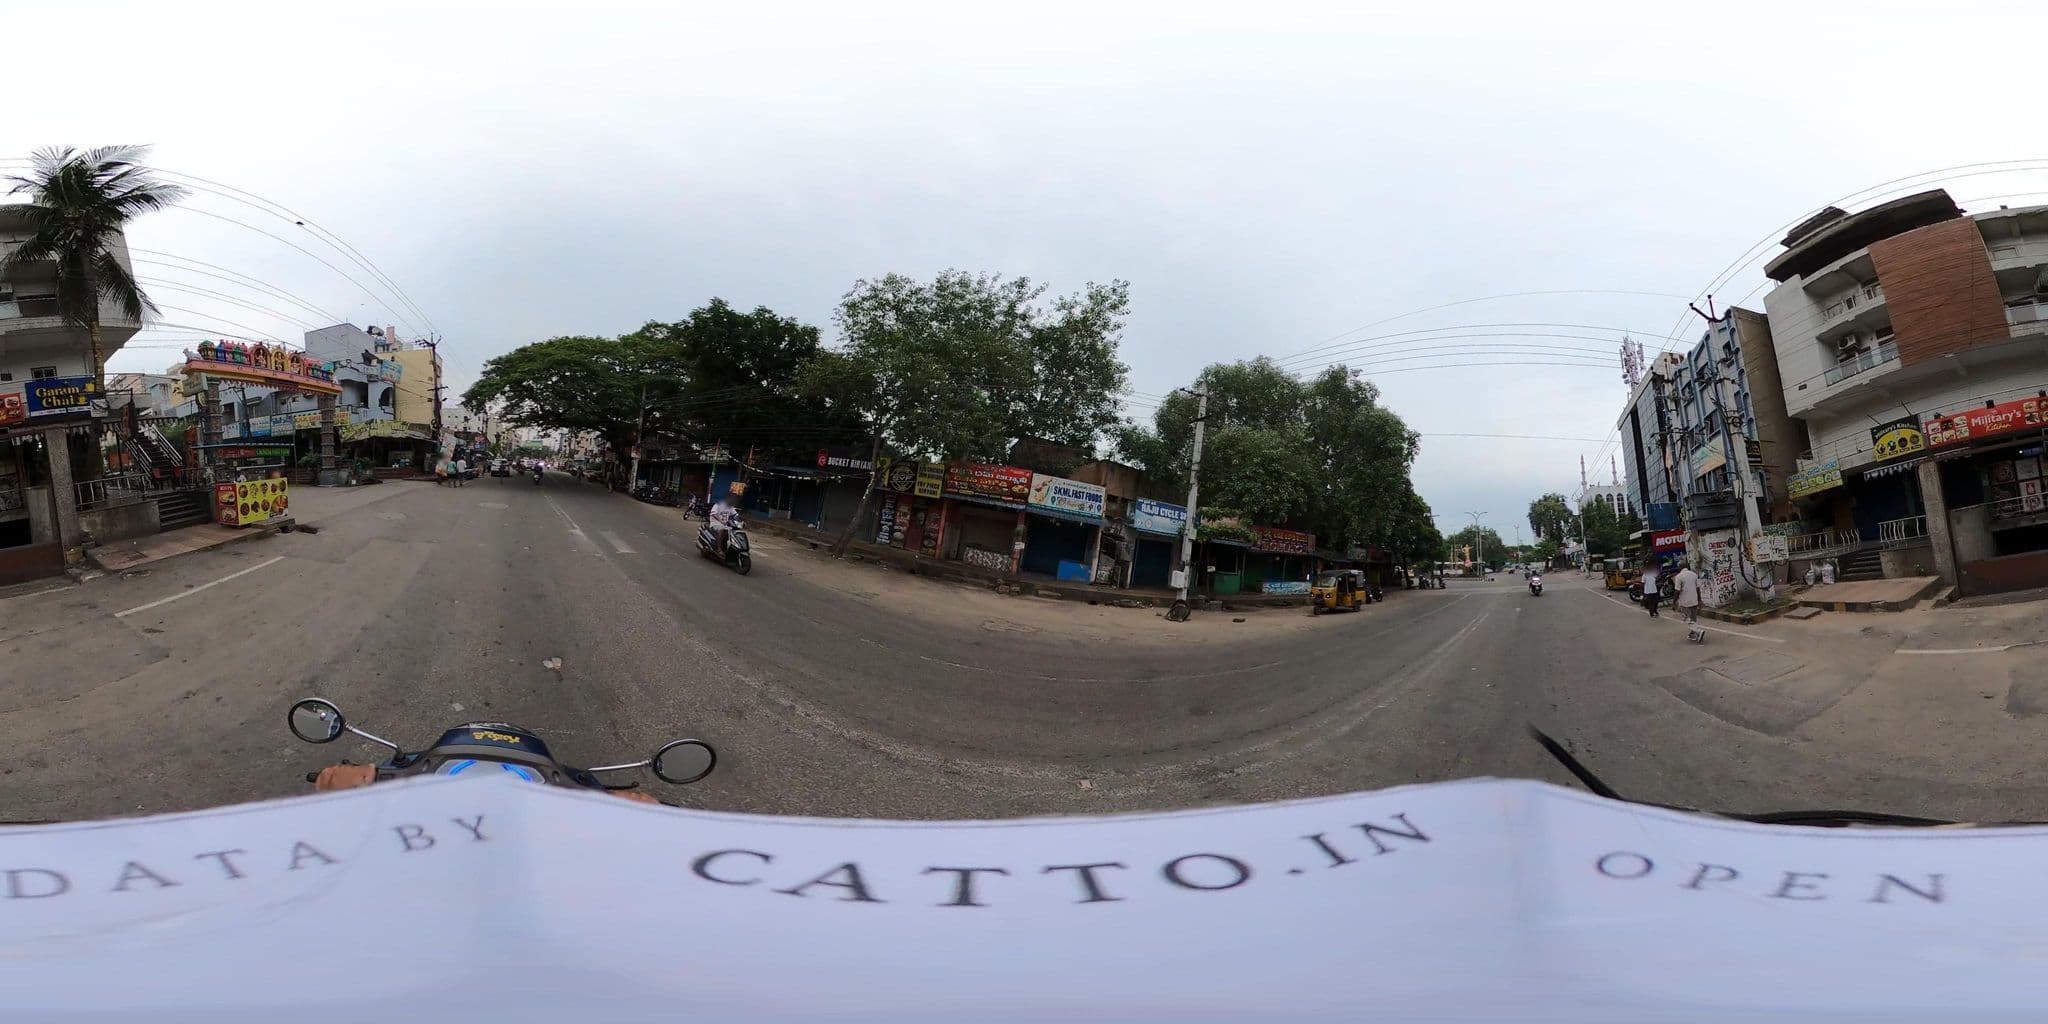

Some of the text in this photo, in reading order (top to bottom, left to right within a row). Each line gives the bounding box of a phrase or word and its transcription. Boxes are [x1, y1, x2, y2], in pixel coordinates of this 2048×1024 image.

[35, 386, 80, 398] Garam
[42, 394, 74, 408] Chai
[1971, 409, 2022, 427] Military's
[827, 456, 850, 468] BUCKET
[1141, 503, 1159, 515] RAJU
[1160, 507, 1180, 519] CYCLE
[2, 840, 341, 900] DATA
[393, 815, 491, 853] BY
[1596, 851, 1945, 903] OPEN
